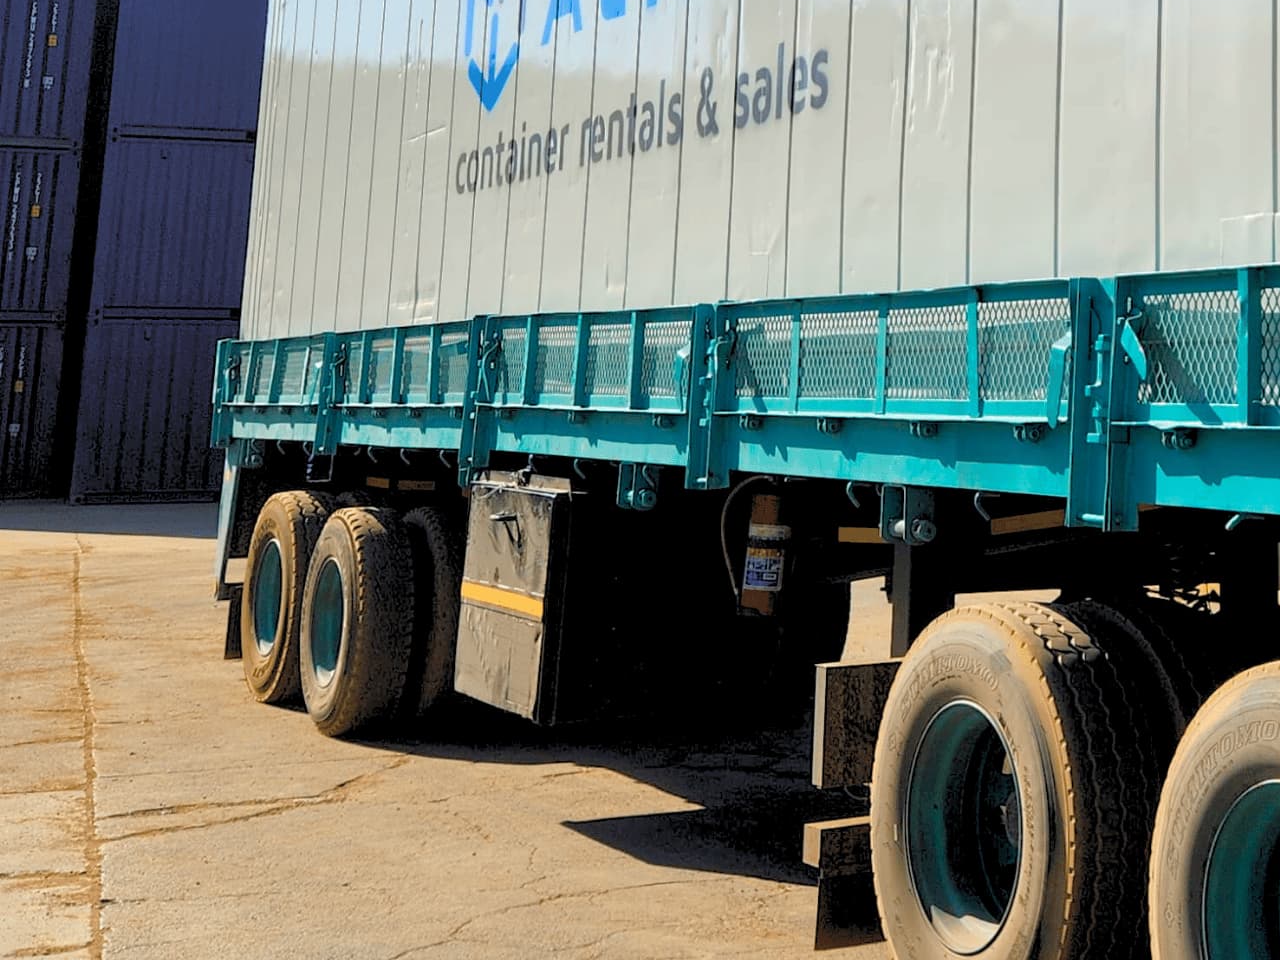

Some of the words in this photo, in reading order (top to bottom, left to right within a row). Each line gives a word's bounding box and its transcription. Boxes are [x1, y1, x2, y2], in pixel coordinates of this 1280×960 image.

[455, 120, 569, 195] container
[579, 78, 682, 168] rentals
[696, 66, 720, 139] &
[735, 41, 830, 131] sales
